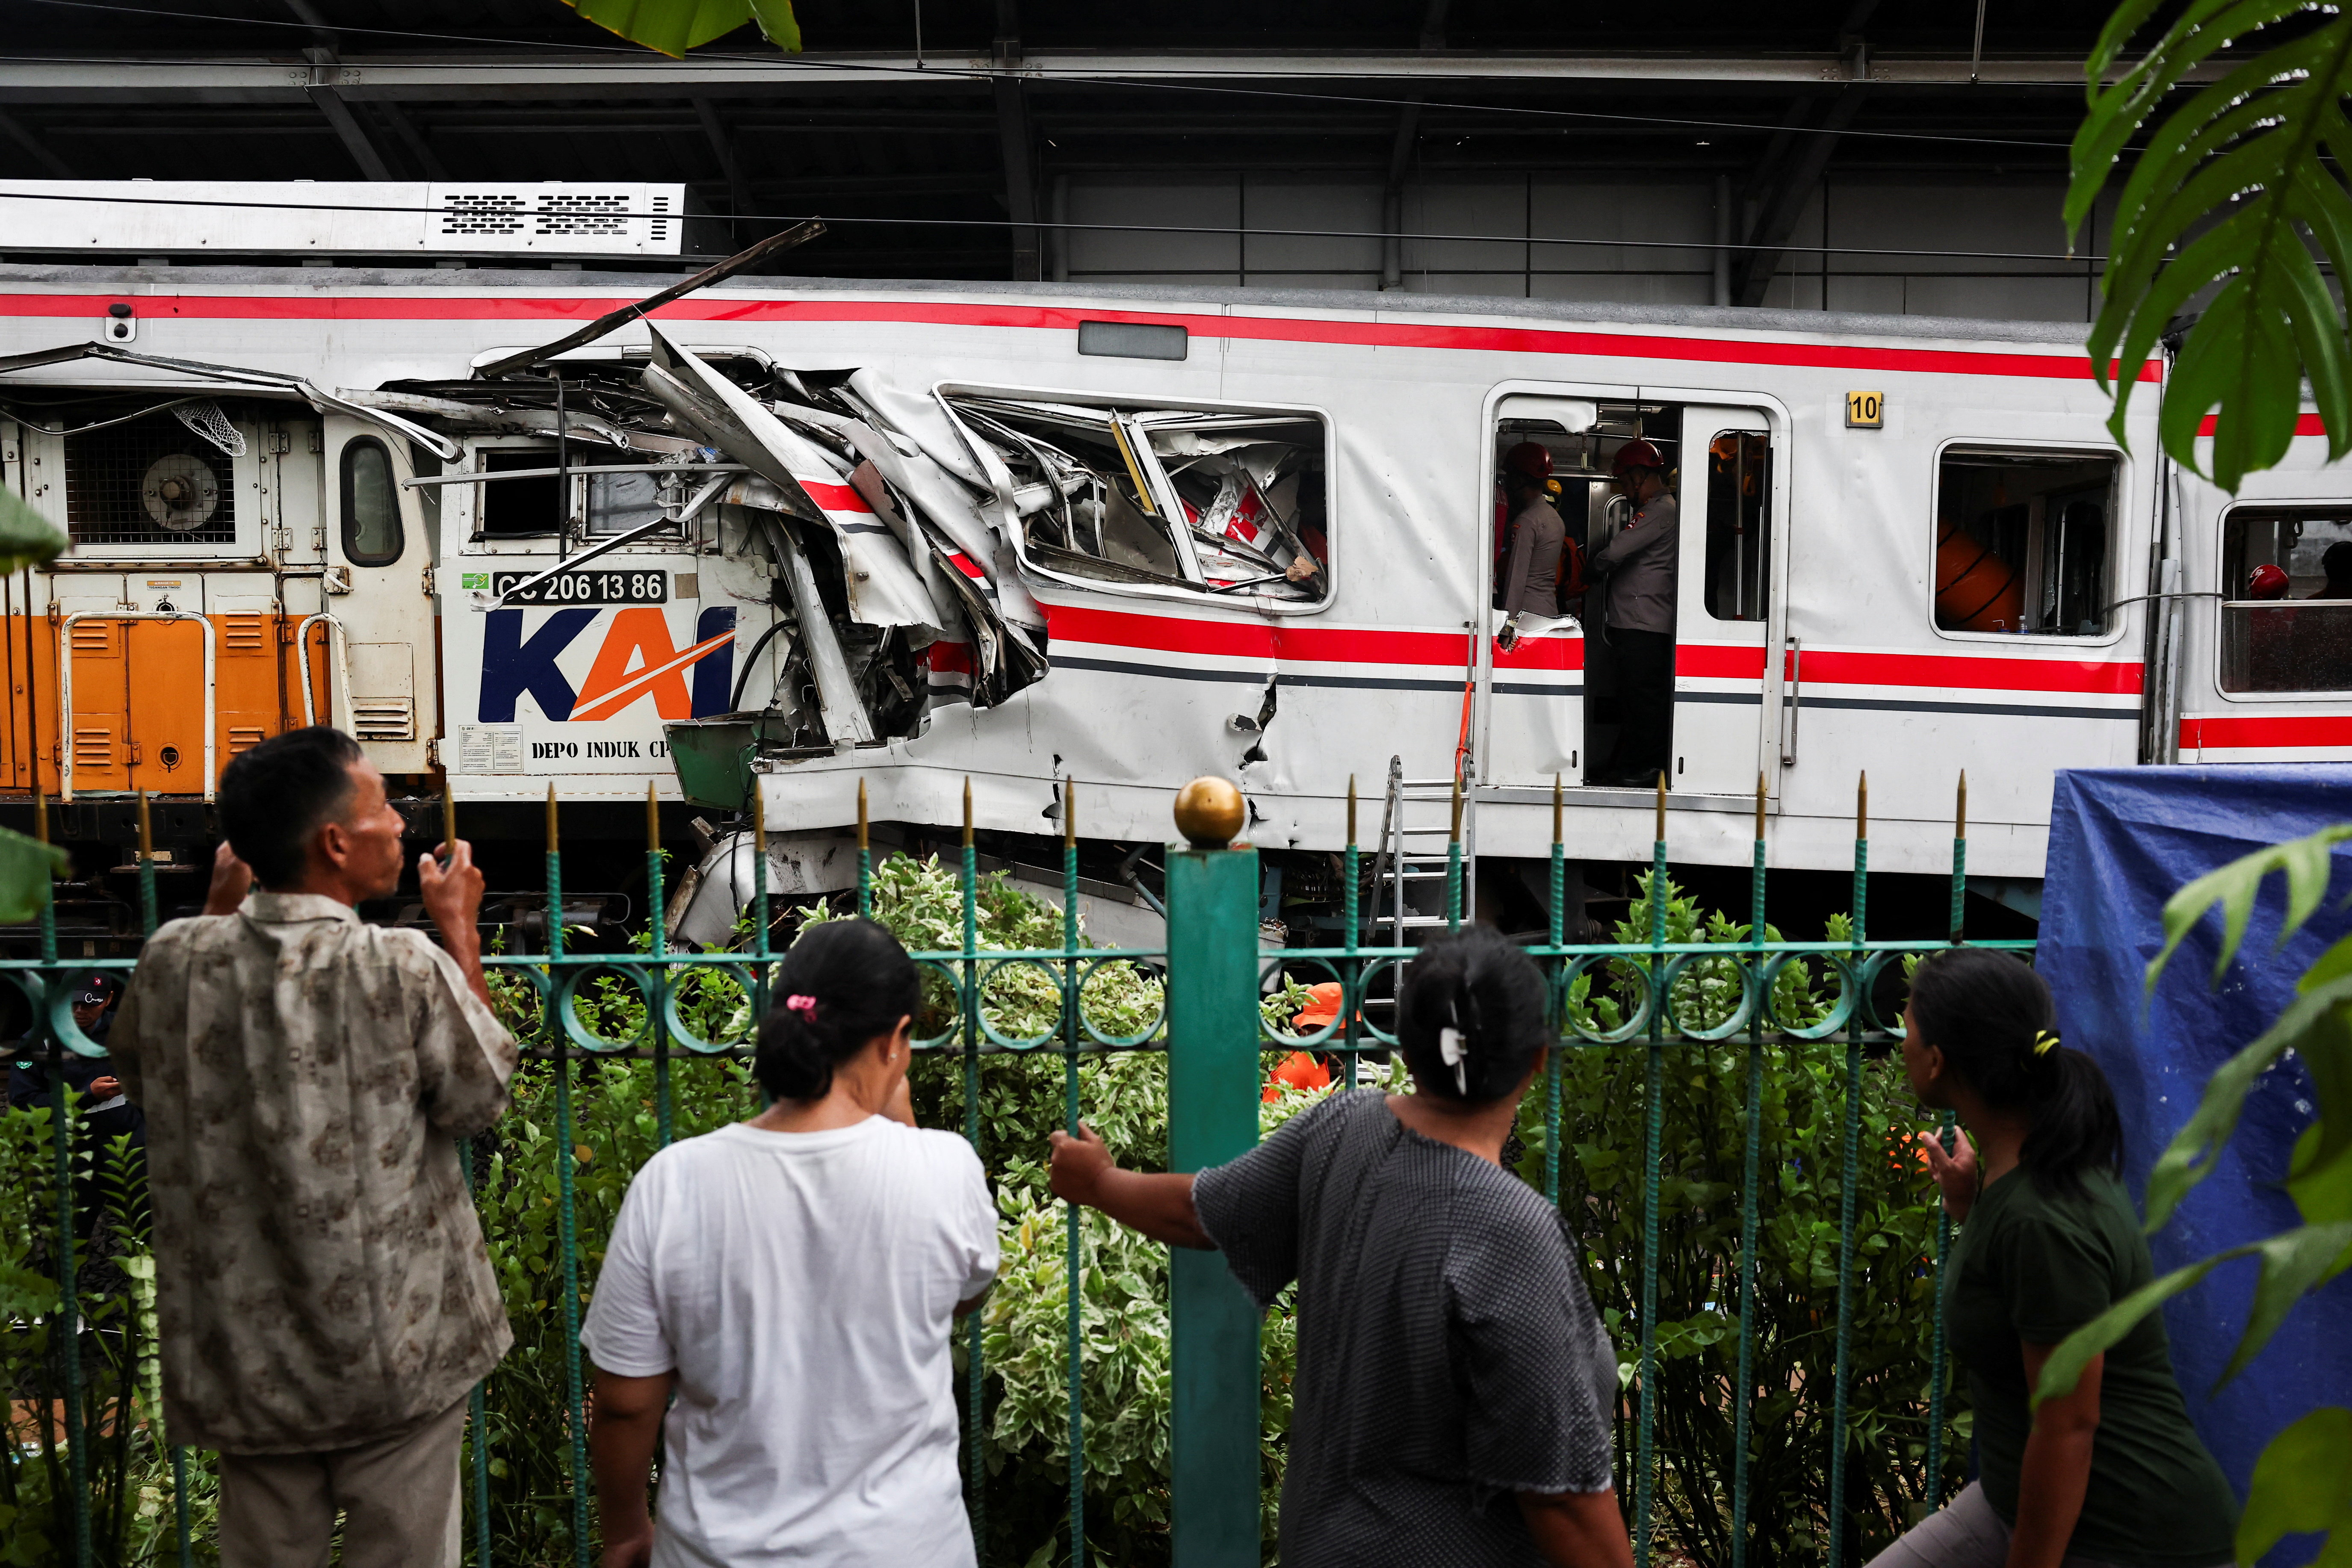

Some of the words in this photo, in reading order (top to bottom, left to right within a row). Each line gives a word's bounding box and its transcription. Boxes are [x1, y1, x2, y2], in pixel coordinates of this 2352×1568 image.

[1853, 396, 1876, 419] 10
[544, 575, 591, 599] 206
[598, 574, 624, 599] 13
[632, 574, 662, 599] 86
[478, 606, 737, 722] KAI
[532, 742, 579, 759] DEPO
[587, 741, 641, 758] INDUK
